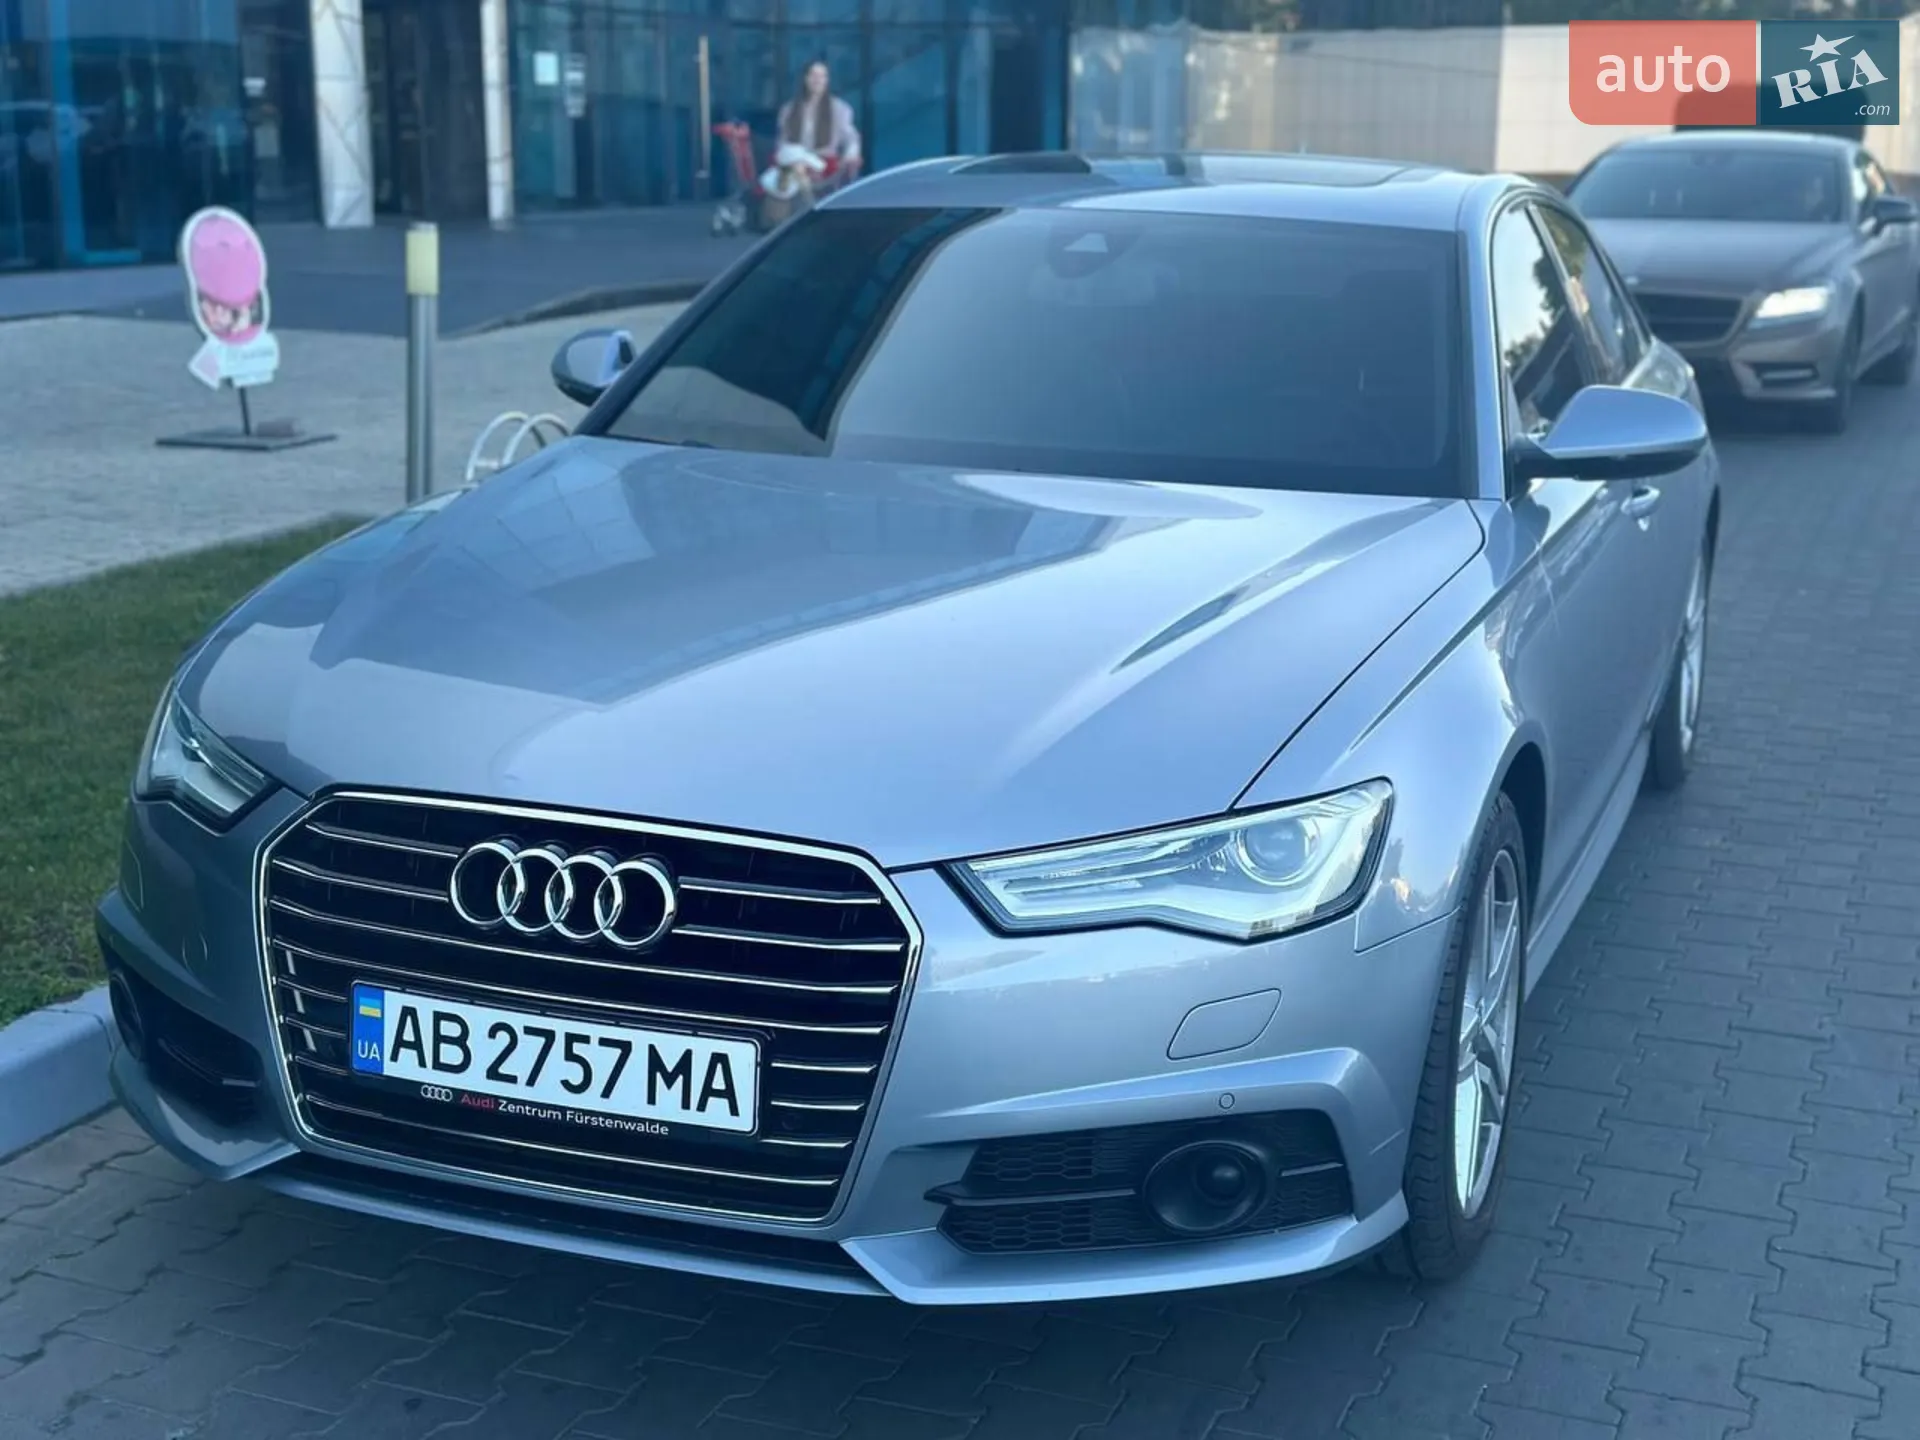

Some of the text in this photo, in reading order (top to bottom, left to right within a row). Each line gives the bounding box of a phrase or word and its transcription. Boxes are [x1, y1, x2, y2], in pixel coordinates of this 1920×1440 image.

[358, 1040, 381, 1062] UA
[390, 1006, 740, 1117] AB 2757 MA
[460, 1093, 669, 1136] Audi Zentrum Fürstenwalde
